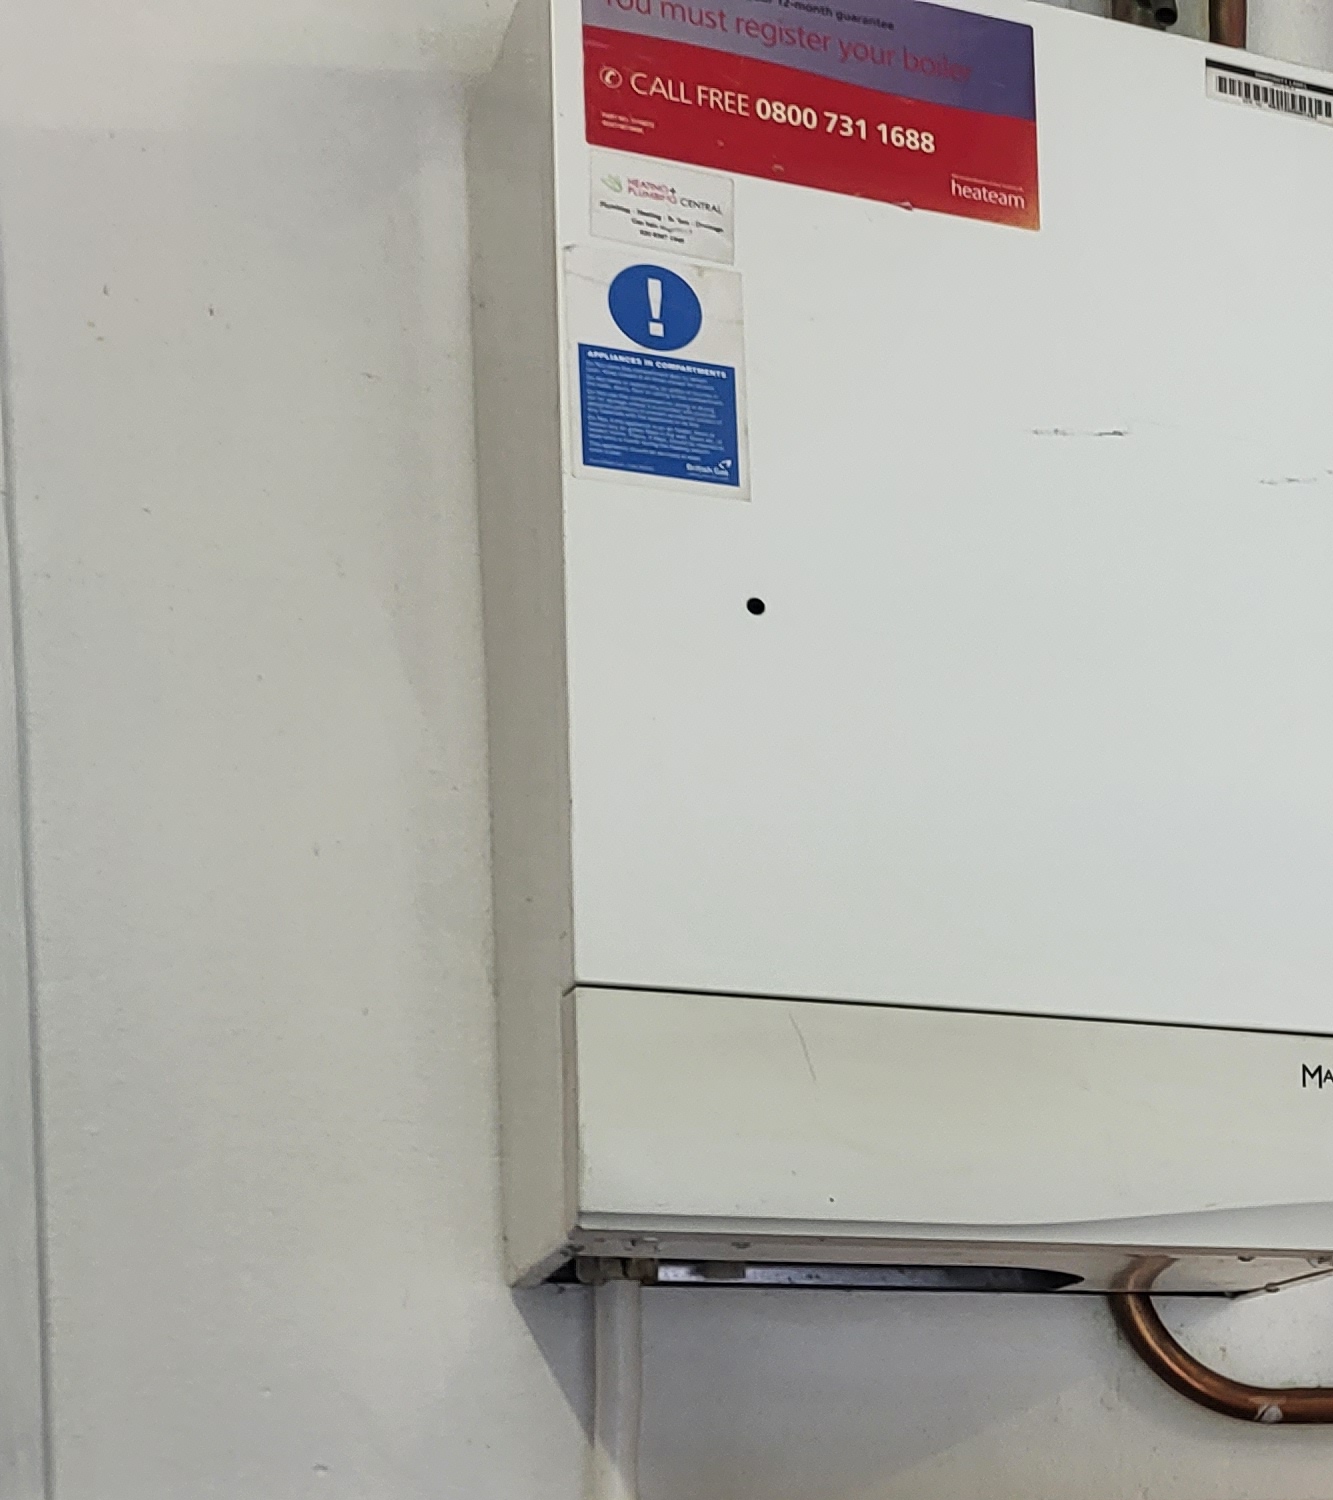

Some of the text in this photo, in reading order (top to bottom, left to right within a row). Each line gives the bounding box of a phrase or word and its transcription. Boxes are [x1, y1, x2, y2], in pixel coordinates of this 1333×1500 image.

[836, 10, 895, 31] guarantee
[660, 1, 728, 33] must
[735, 17, 832, 52] register
[838, 38, 896, 66] your
[902, 46, 972, 83] boiler
[629, 72, 935, 154] CALL FREE 0800 731 1688
[679, 198, 723, 216] CENTRAL
[950, 179, 1025, 210] heateam
